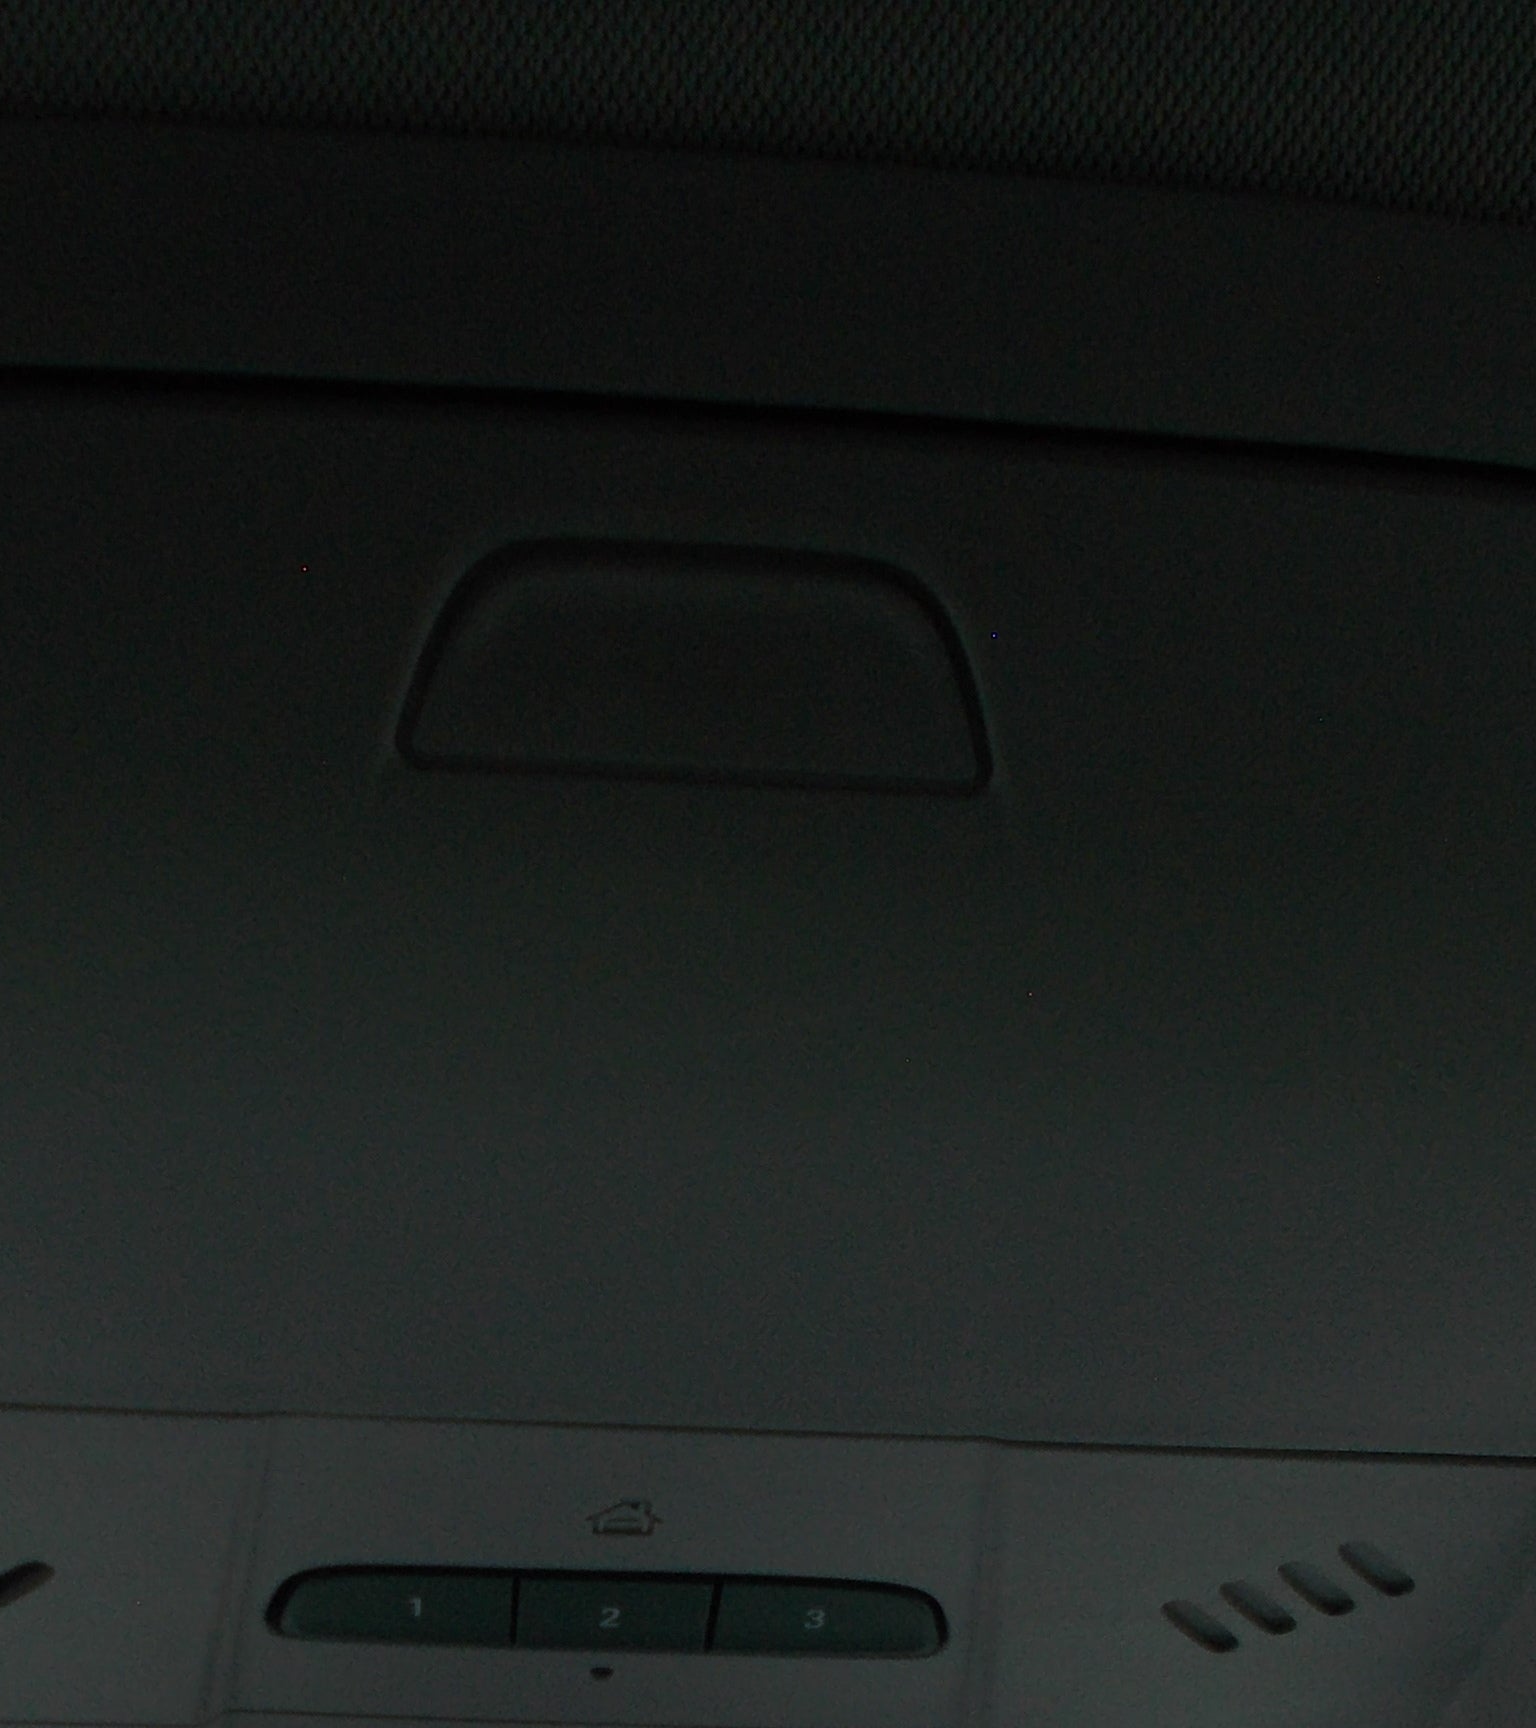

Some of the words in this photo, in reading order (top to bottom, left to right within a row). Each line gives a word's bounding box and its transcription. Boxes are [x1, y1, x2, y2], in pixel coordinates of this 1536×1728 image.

[410, 1596, 422, 1617] 1
[598, 1607, 621, 1629] 2
[803, 1608, 827, 1630] 3
